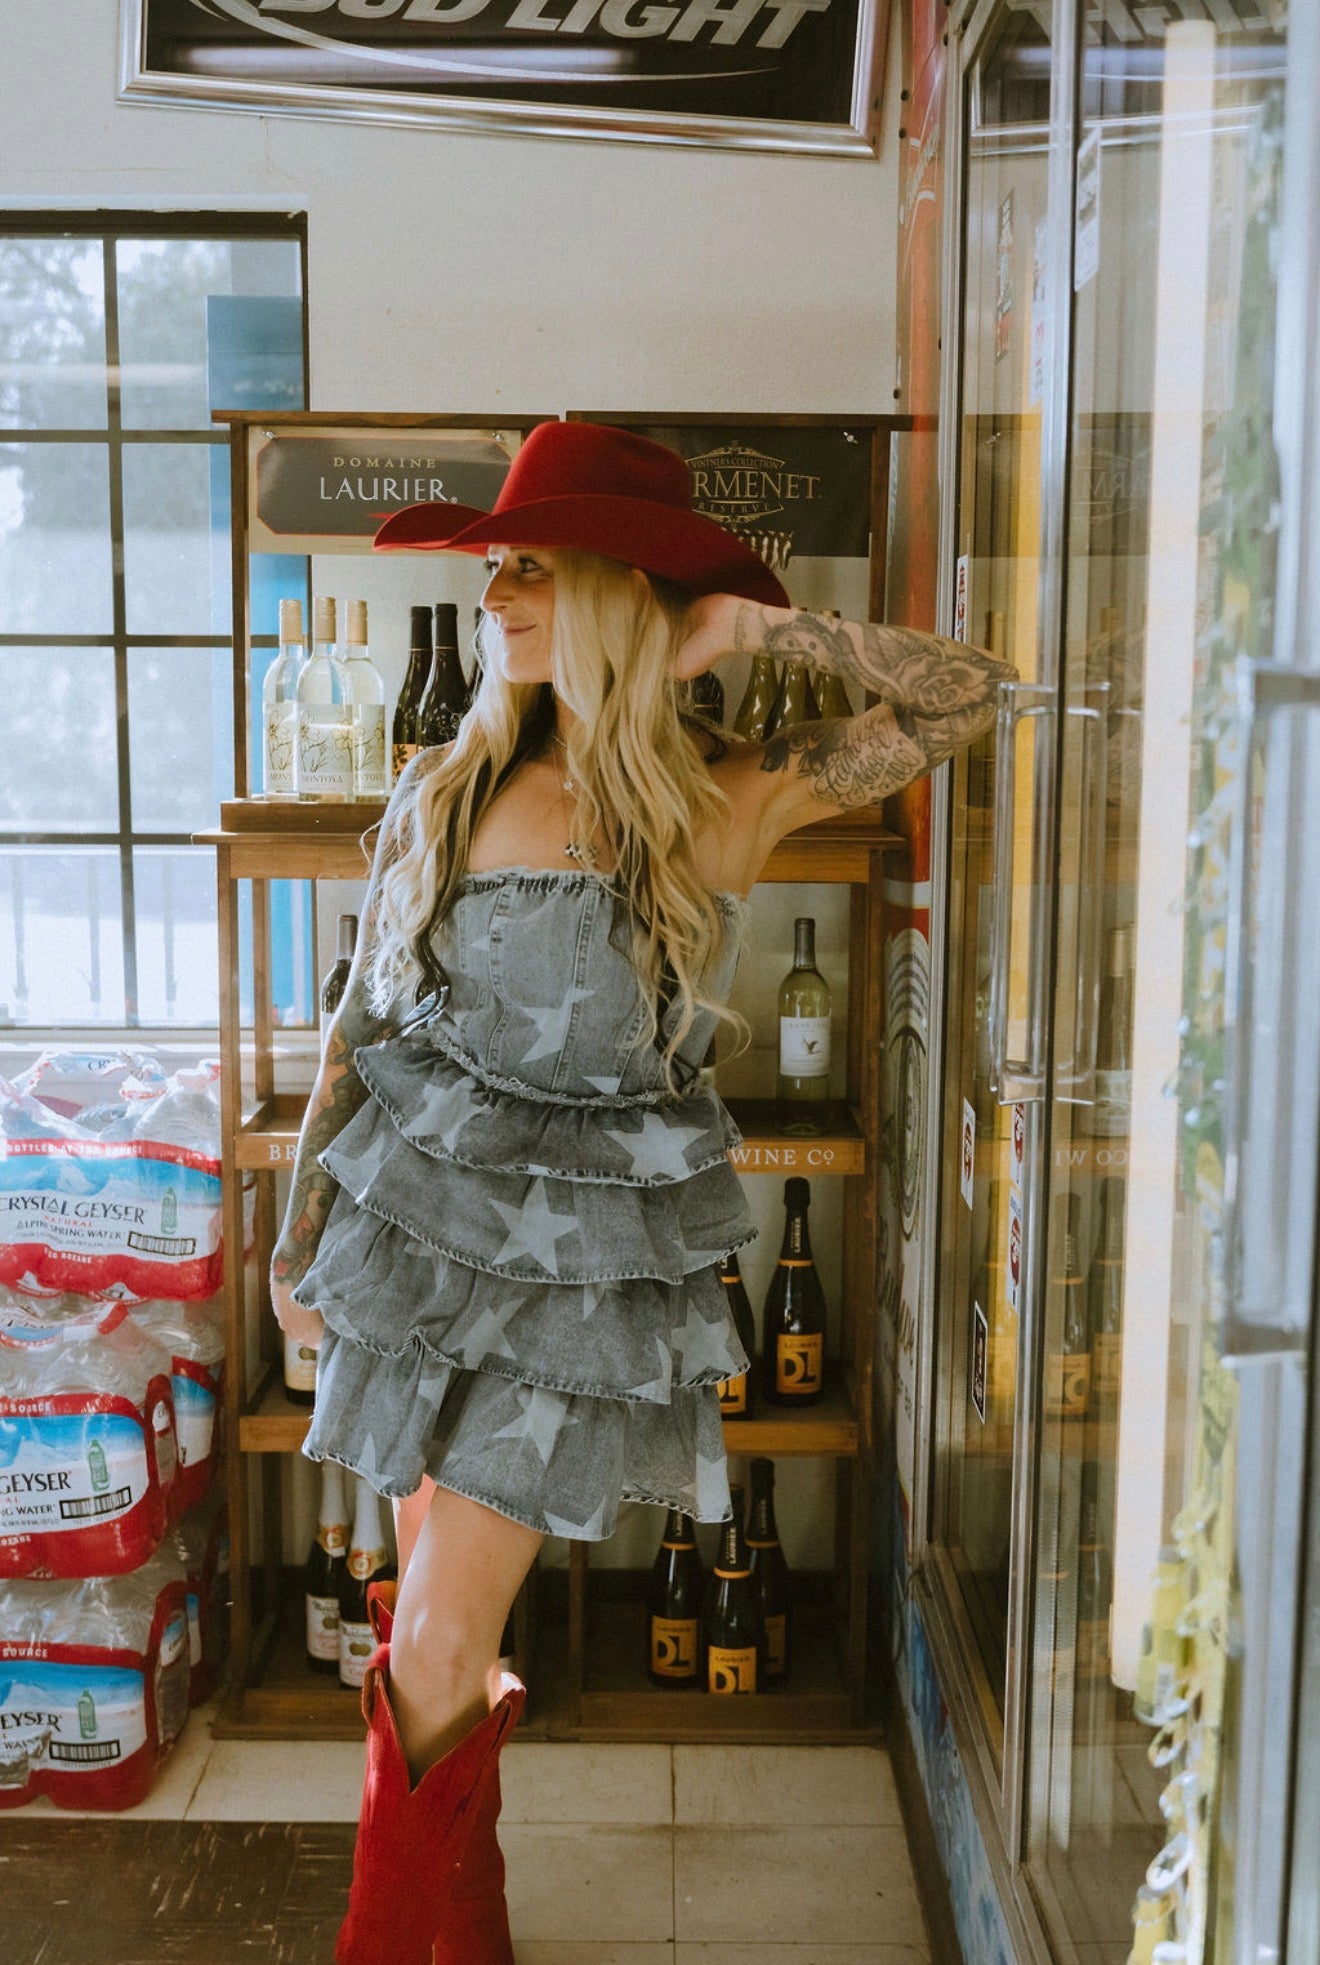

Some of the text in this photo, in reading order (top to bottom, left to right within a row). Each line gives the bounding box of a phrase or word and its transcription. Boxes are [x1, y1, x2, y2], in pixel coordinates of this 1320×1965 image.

[504, 0, 827, 49] LIGHT
[333, 456, 436, 469] DOMAINE
[320, 476, 448, 501] LAURIER
[729, 1149, 797, 1165] WINE
[74, 1201, 146, 1225] GEYSER
[17, 1504, 54, 1515] WATER
[2, 1647, 48, 1658] SOURCE
